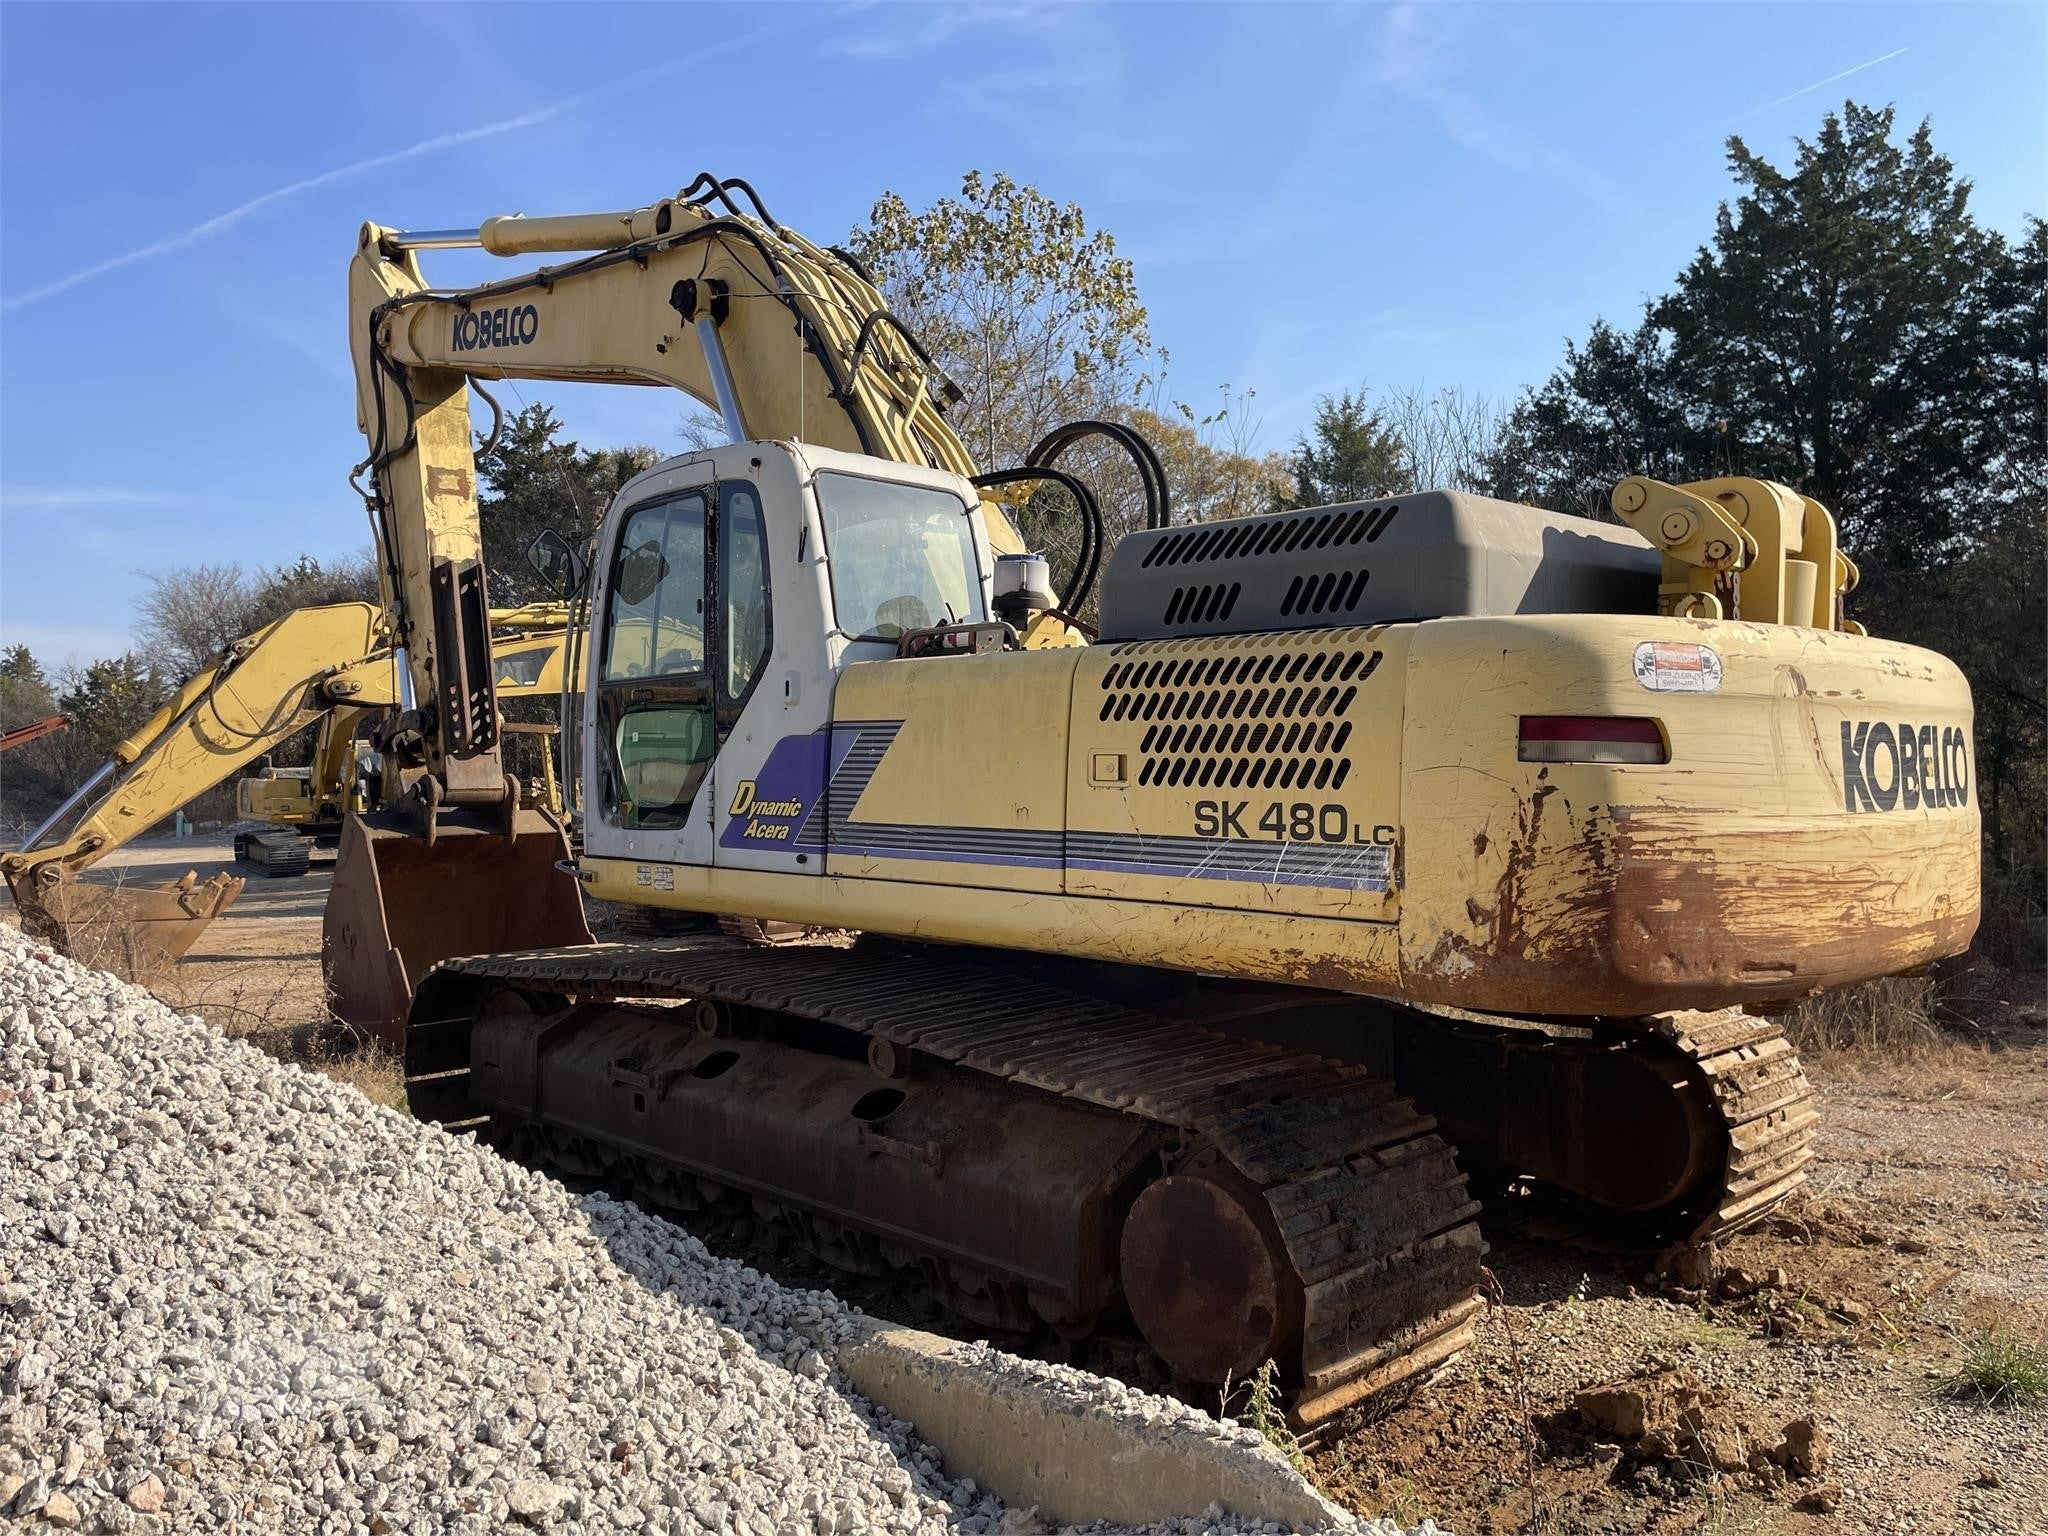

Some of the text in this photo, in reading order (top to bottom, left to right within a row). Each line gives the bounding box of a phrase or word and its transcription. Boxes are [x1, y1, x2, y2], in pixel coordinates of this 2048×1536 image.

[452, 304, 539, 352] KOBELCO
[1841, 721, 1968, 812] KOBELCO
[729, 780, 802, 820] Dynamic
[1194, 800, 1395, 846] SK 480 LC
[743, 819, 790, 840] Acera
